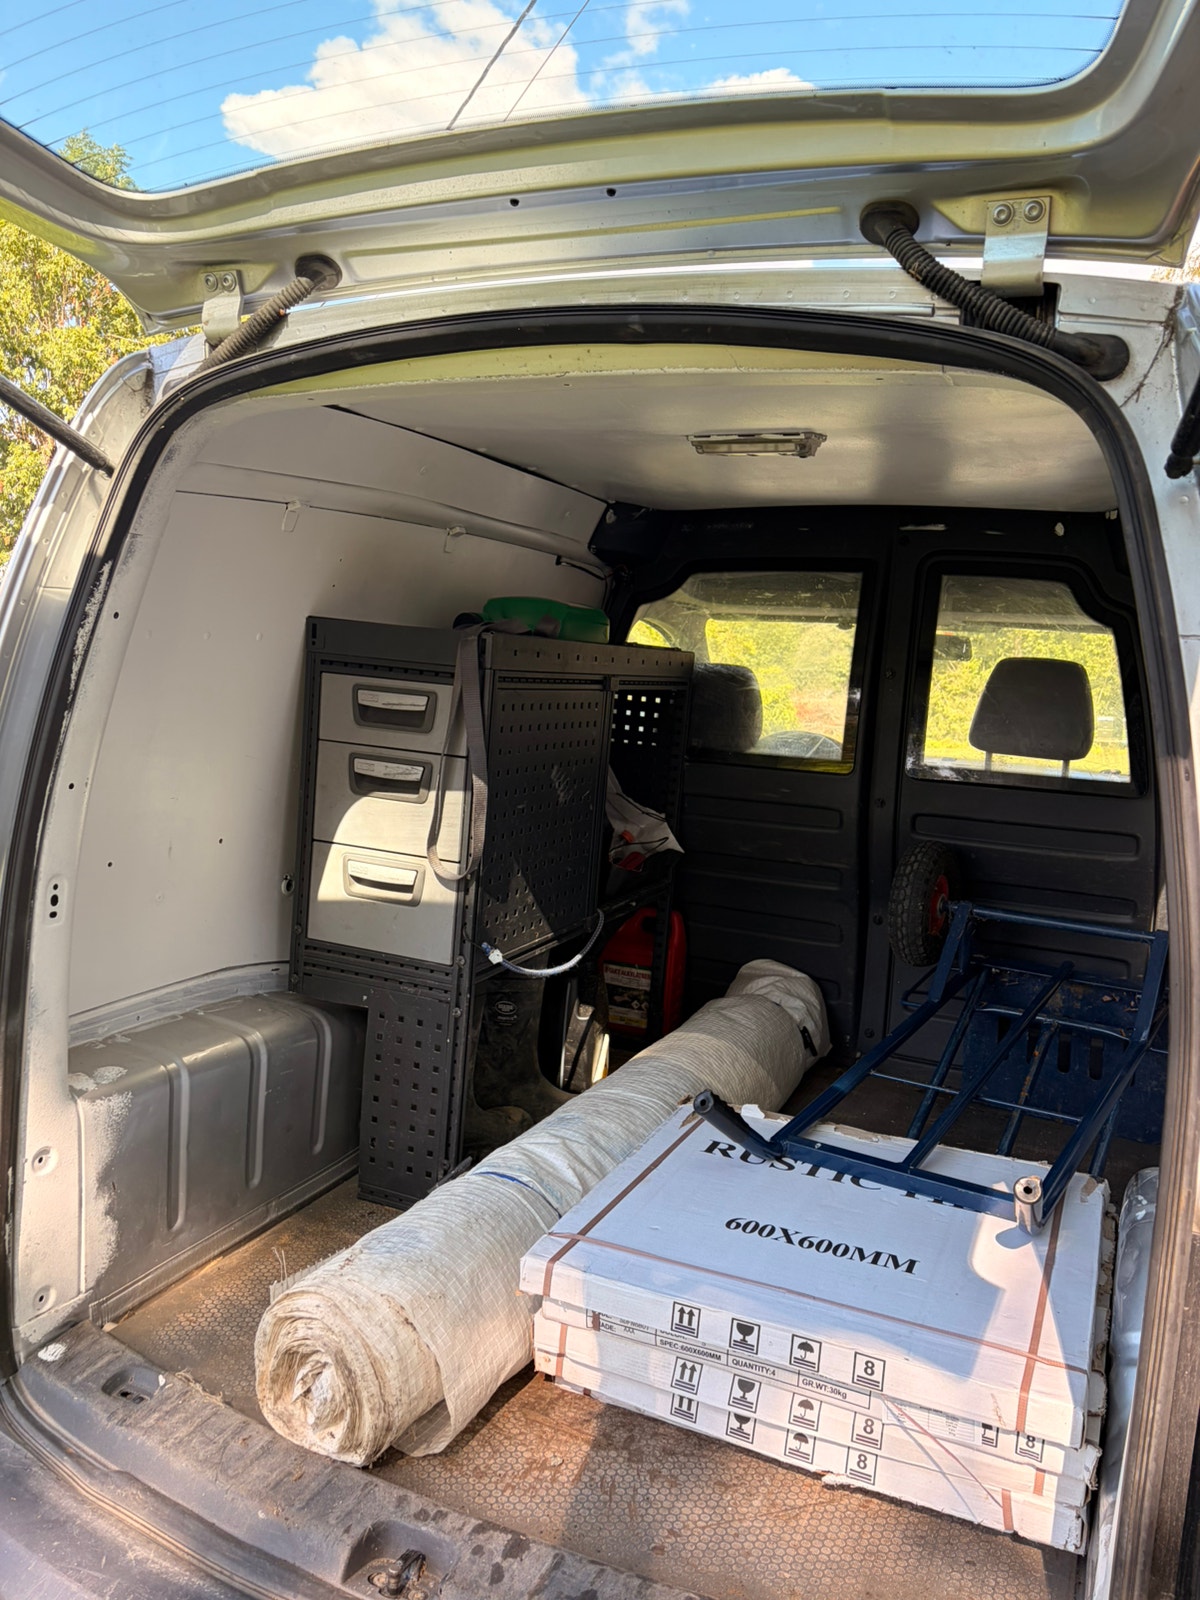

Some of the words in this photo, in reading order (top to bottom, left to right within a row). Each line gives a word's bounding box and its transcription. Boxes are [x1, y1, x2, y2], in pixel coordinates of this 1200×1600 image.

[725, 1217, 920, 1275] 600X600MM
[732, 1358, 776, 1376] QUANTITY:4
[864, 1360, 875, 1376] 8
[863, 1418, 875, 1435] 8
[1026, 1434, 1036, 1449] 8
[857, 1453, 868, 1470] 8
